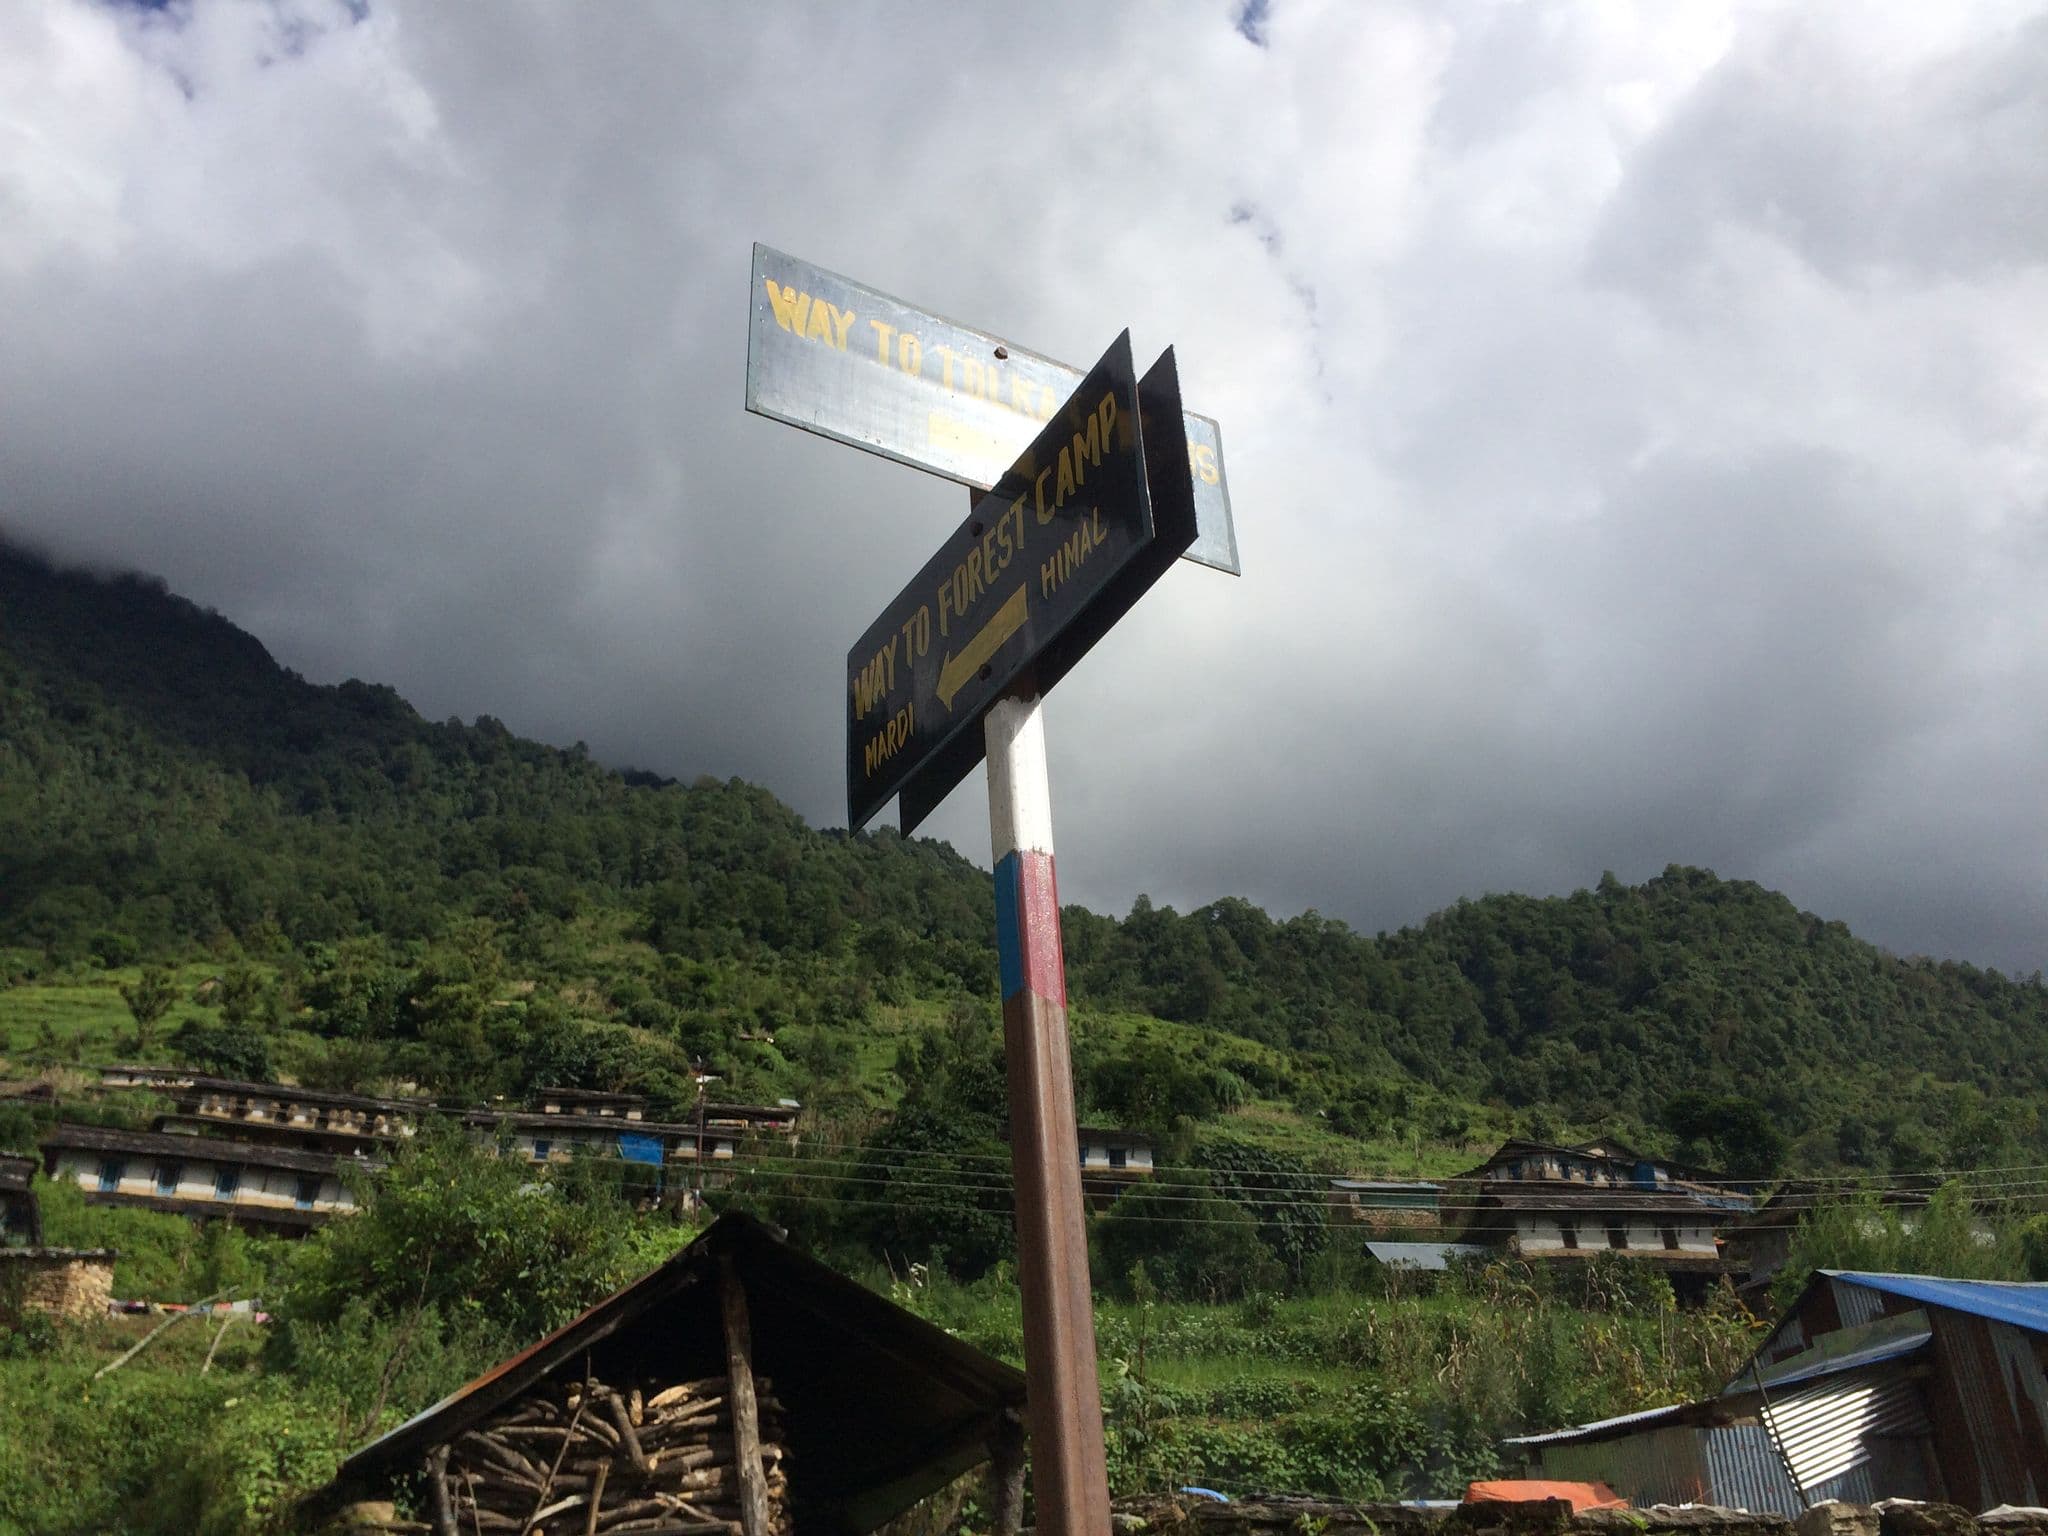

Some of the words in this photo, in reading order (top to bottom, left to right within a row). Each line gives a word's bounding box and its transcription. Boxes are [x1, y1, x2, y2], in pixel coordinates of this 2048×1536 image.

[766, 280, 856, 352] WAY
[870, 319, 921, 376] TO
[853, 635, 897, 720] WAY
[902, 605, 930, 668] TO
[937, 491, 1028, 637] FOREST
[1034, 391, 1117, 525] CAMP
[864, 701, 914, 778] MARDI
[1041, 508, 1108, 599] HIMAL
